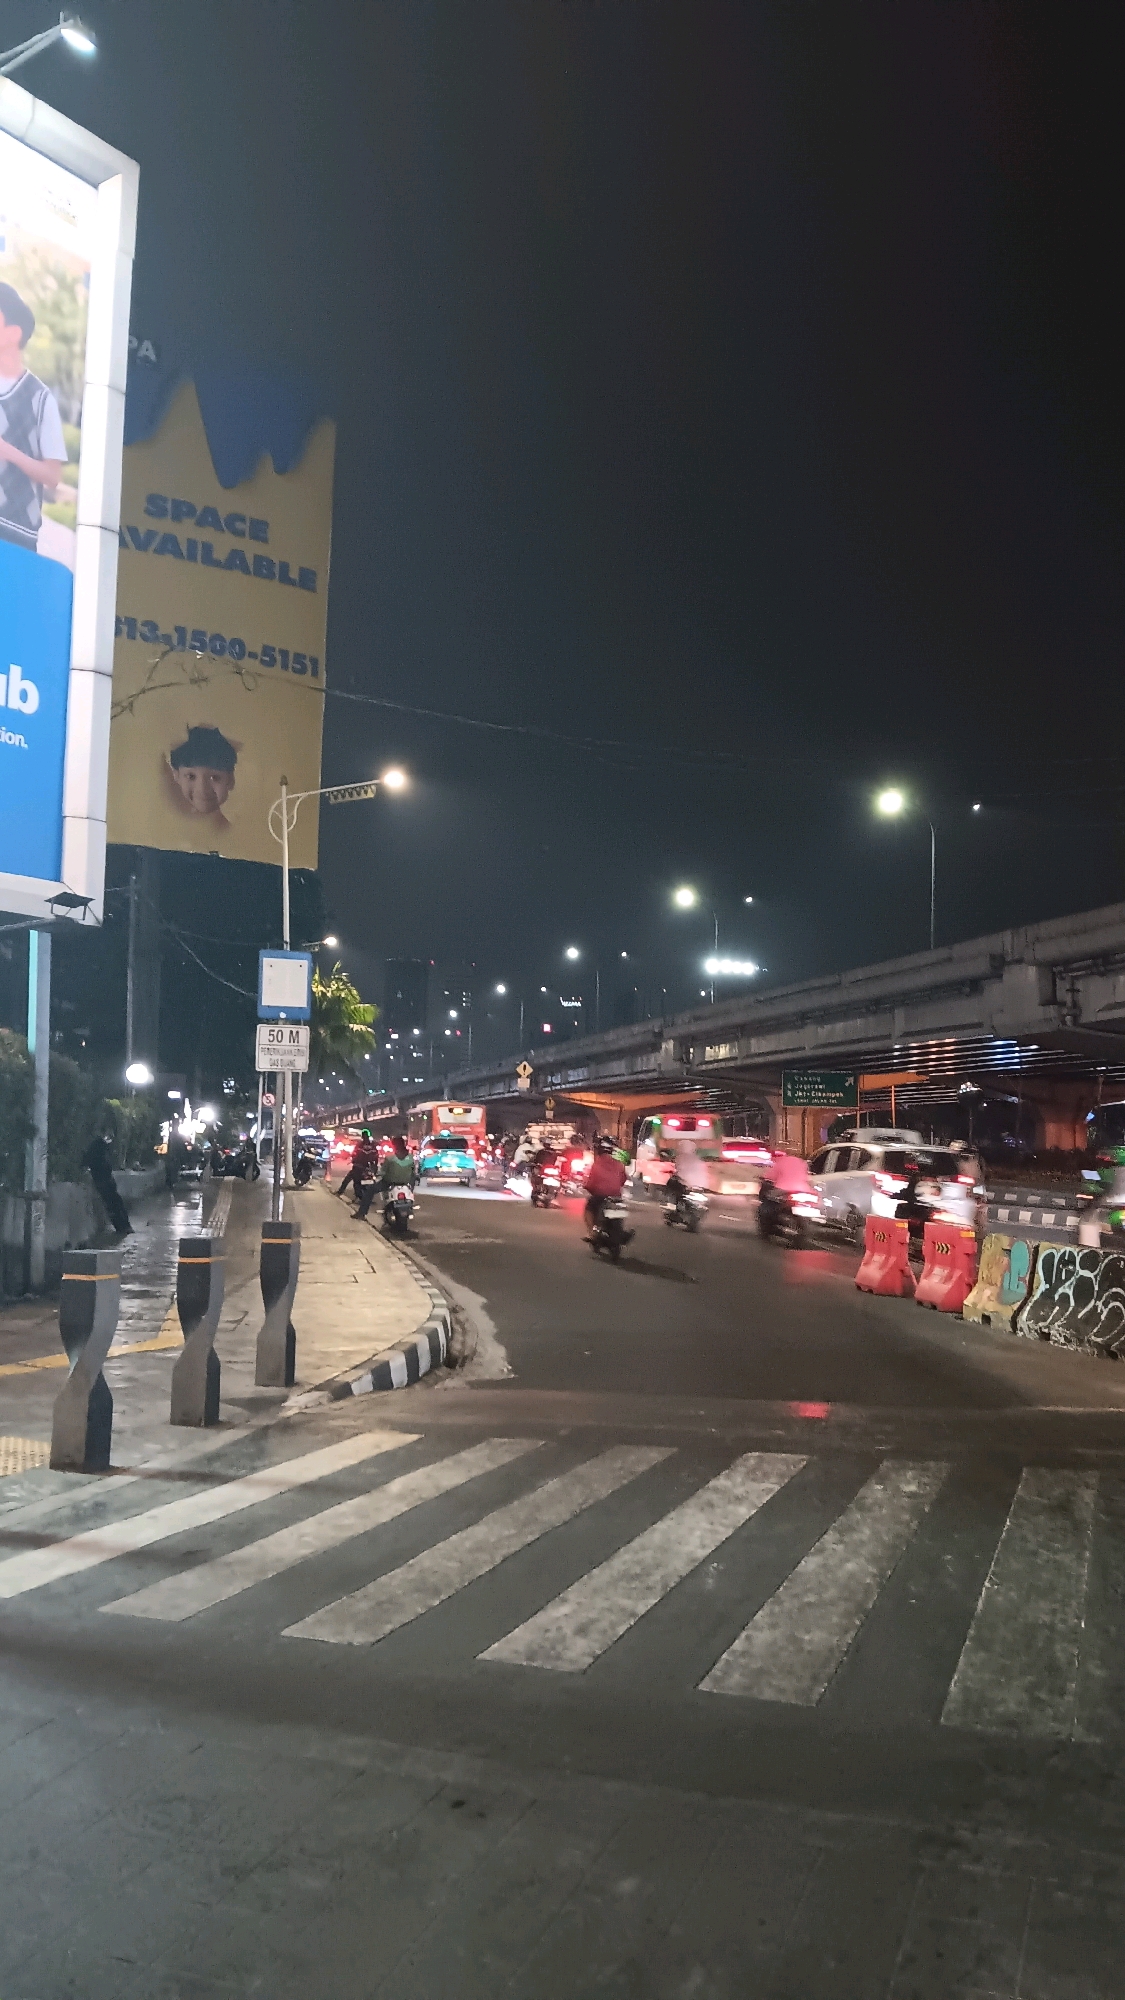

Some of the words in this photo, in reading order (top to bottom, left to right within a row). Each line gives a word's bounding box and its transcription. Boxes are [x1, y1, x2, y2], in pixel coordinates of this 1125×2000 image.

[144, 493, 269, 544] SPACE
[0, 663, 40, 715] b
[0, 726, 29, 749] ion.
[268, 1029, 283, 1043] 50
[289, 1030, 299, 1043] M
